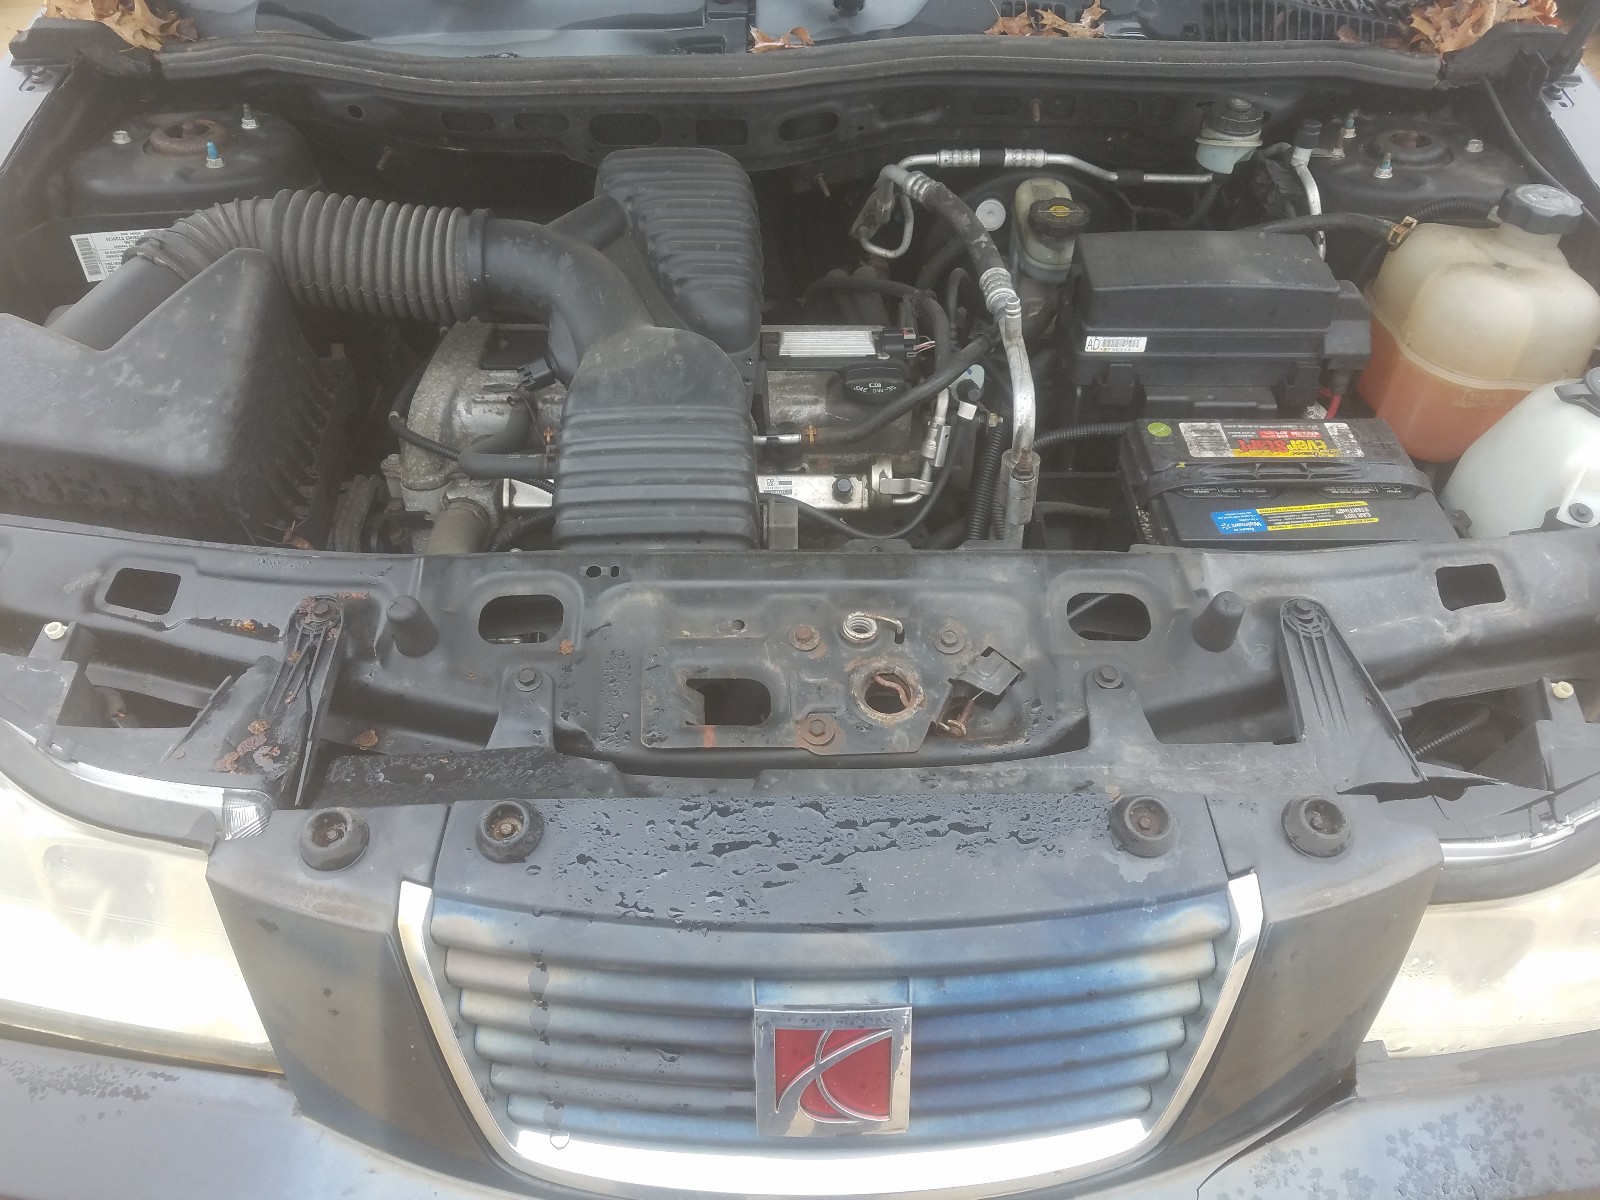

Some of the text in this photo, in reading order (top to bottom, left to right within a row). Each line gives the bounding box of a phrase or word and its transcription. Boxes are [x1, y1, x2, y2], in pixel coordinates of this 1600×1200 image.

[1086, 339, 1101, 350] AD
[1237, 438, 1328, 454] EverStart
[1230, 521, 1262, 529] Walmart
